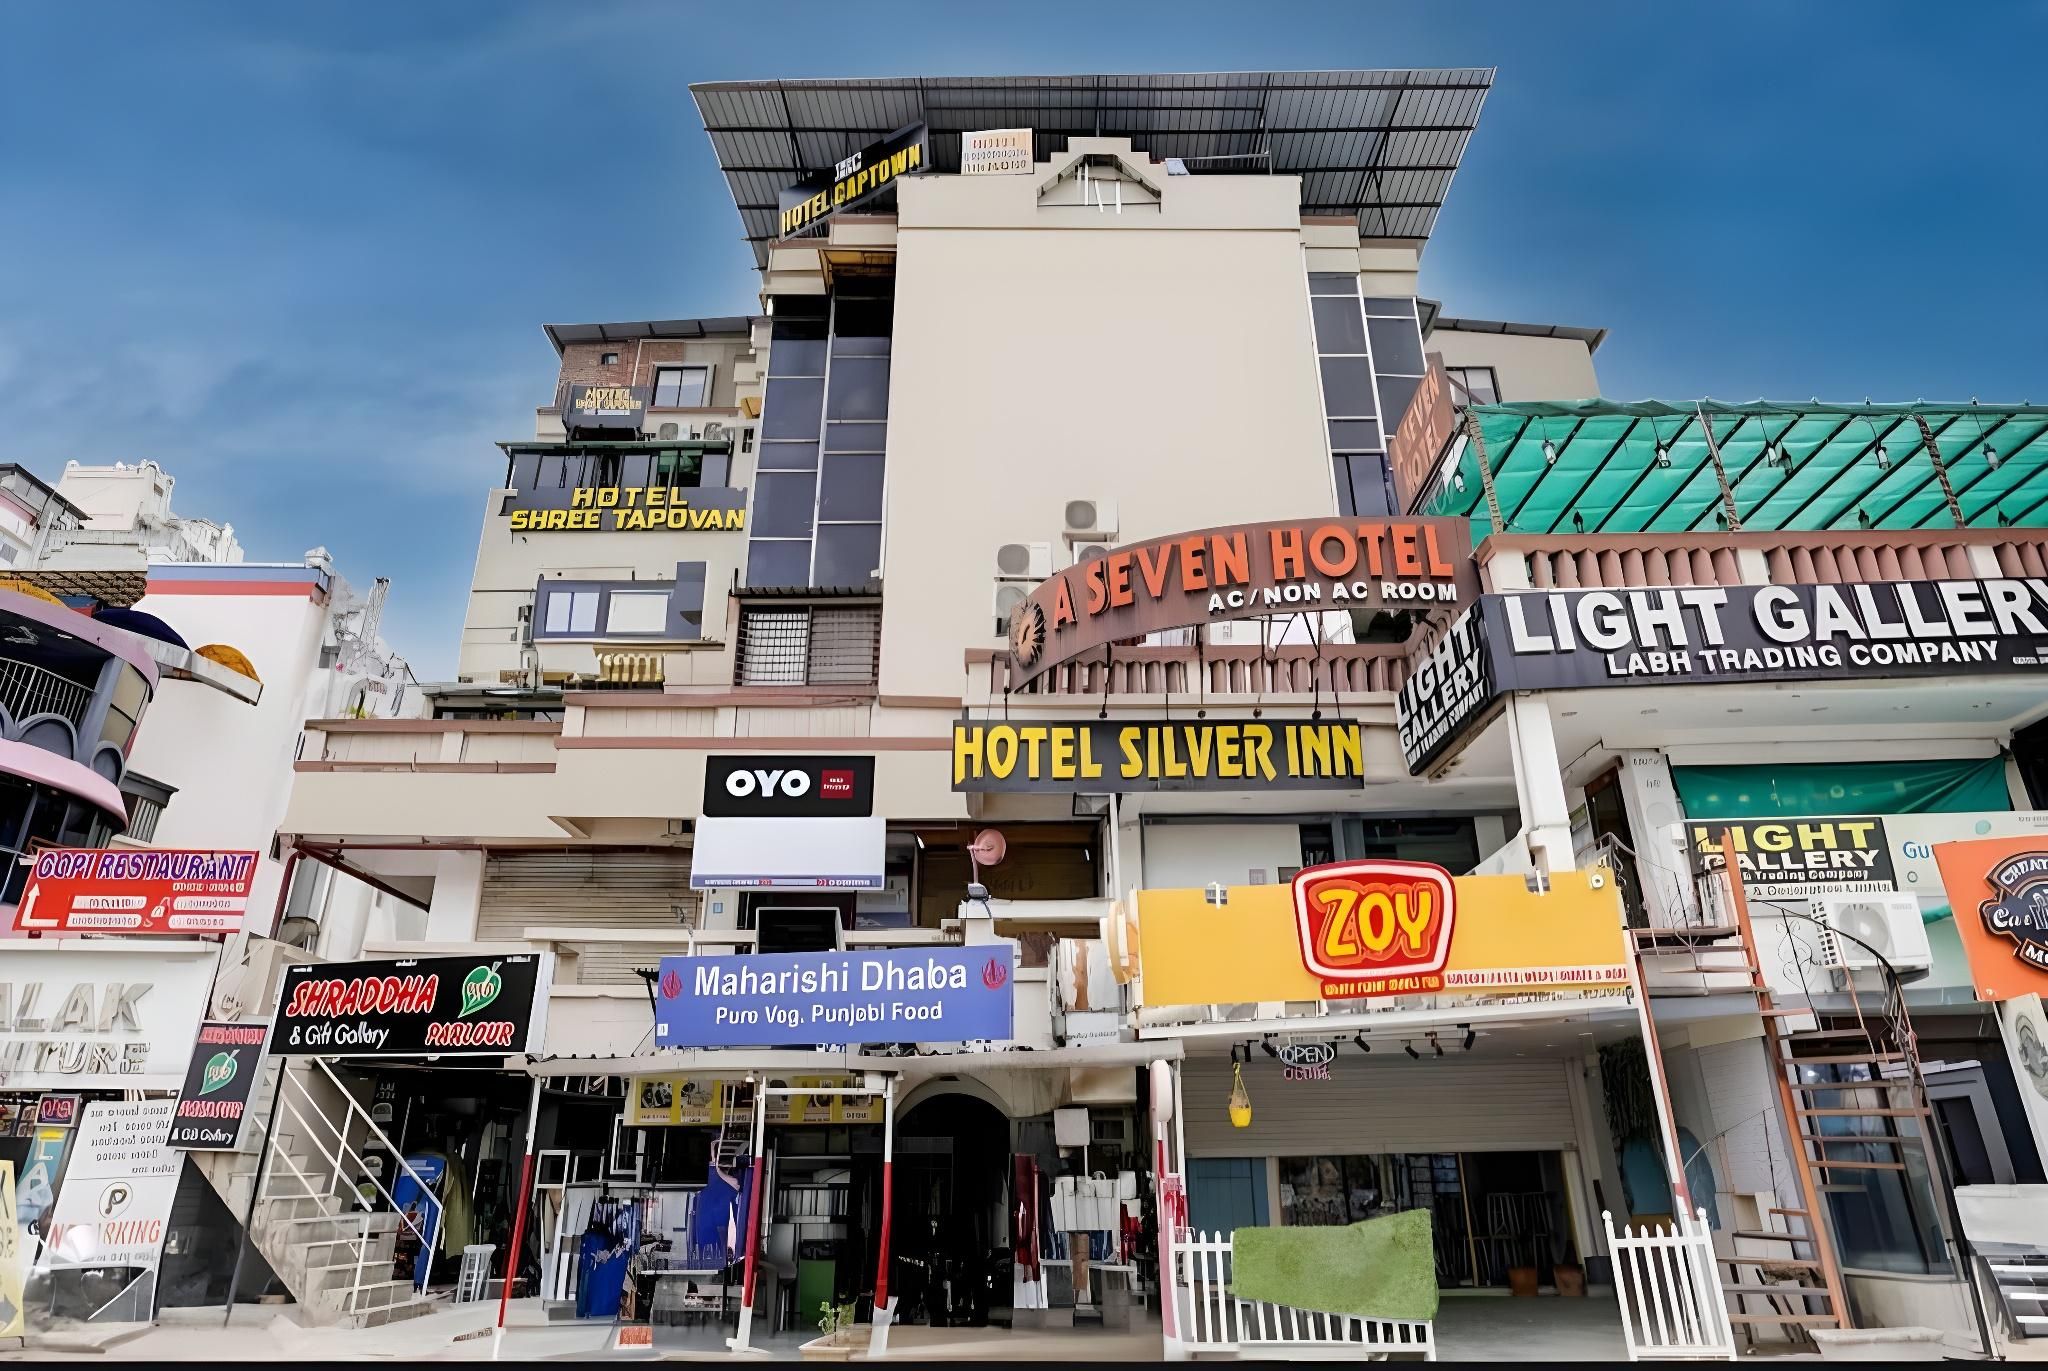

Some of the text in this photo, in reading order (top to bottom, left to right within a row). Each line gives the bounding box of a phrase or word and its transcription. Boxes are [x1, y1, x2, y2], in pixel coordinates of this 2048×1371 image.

[571, 487, 688, 507] HOTEL
[511, 508, 746, 530] SHREE TAPOVAN
[1053, 525, 1454, 631] A SEVEN HOTEL
[1333, 582, 1368, 600] AC
[1381, 581, 1457, 601] ROOM
[1504, 588, 1728, 652] LIGHT
[1395, 606, 1474, 730] LIGHT
[1607, 640, 1998, 675] LABH TRADING COMPANY
[1400, 648, 1480, 751] GALLERY
[954, 724, 1365, 784] HOTEL SILVER INN
[726, 770, 811, 797] OYO
[1694, 823, 1875, 853] LIGHT
[1317, 888, 1433, 957] ZOY
[286, 974, 439, 1018] SHRADDHA
[694, 958, 967, 996] Maharishi Dhaba
[892, 1001, 942, 1021] Food
